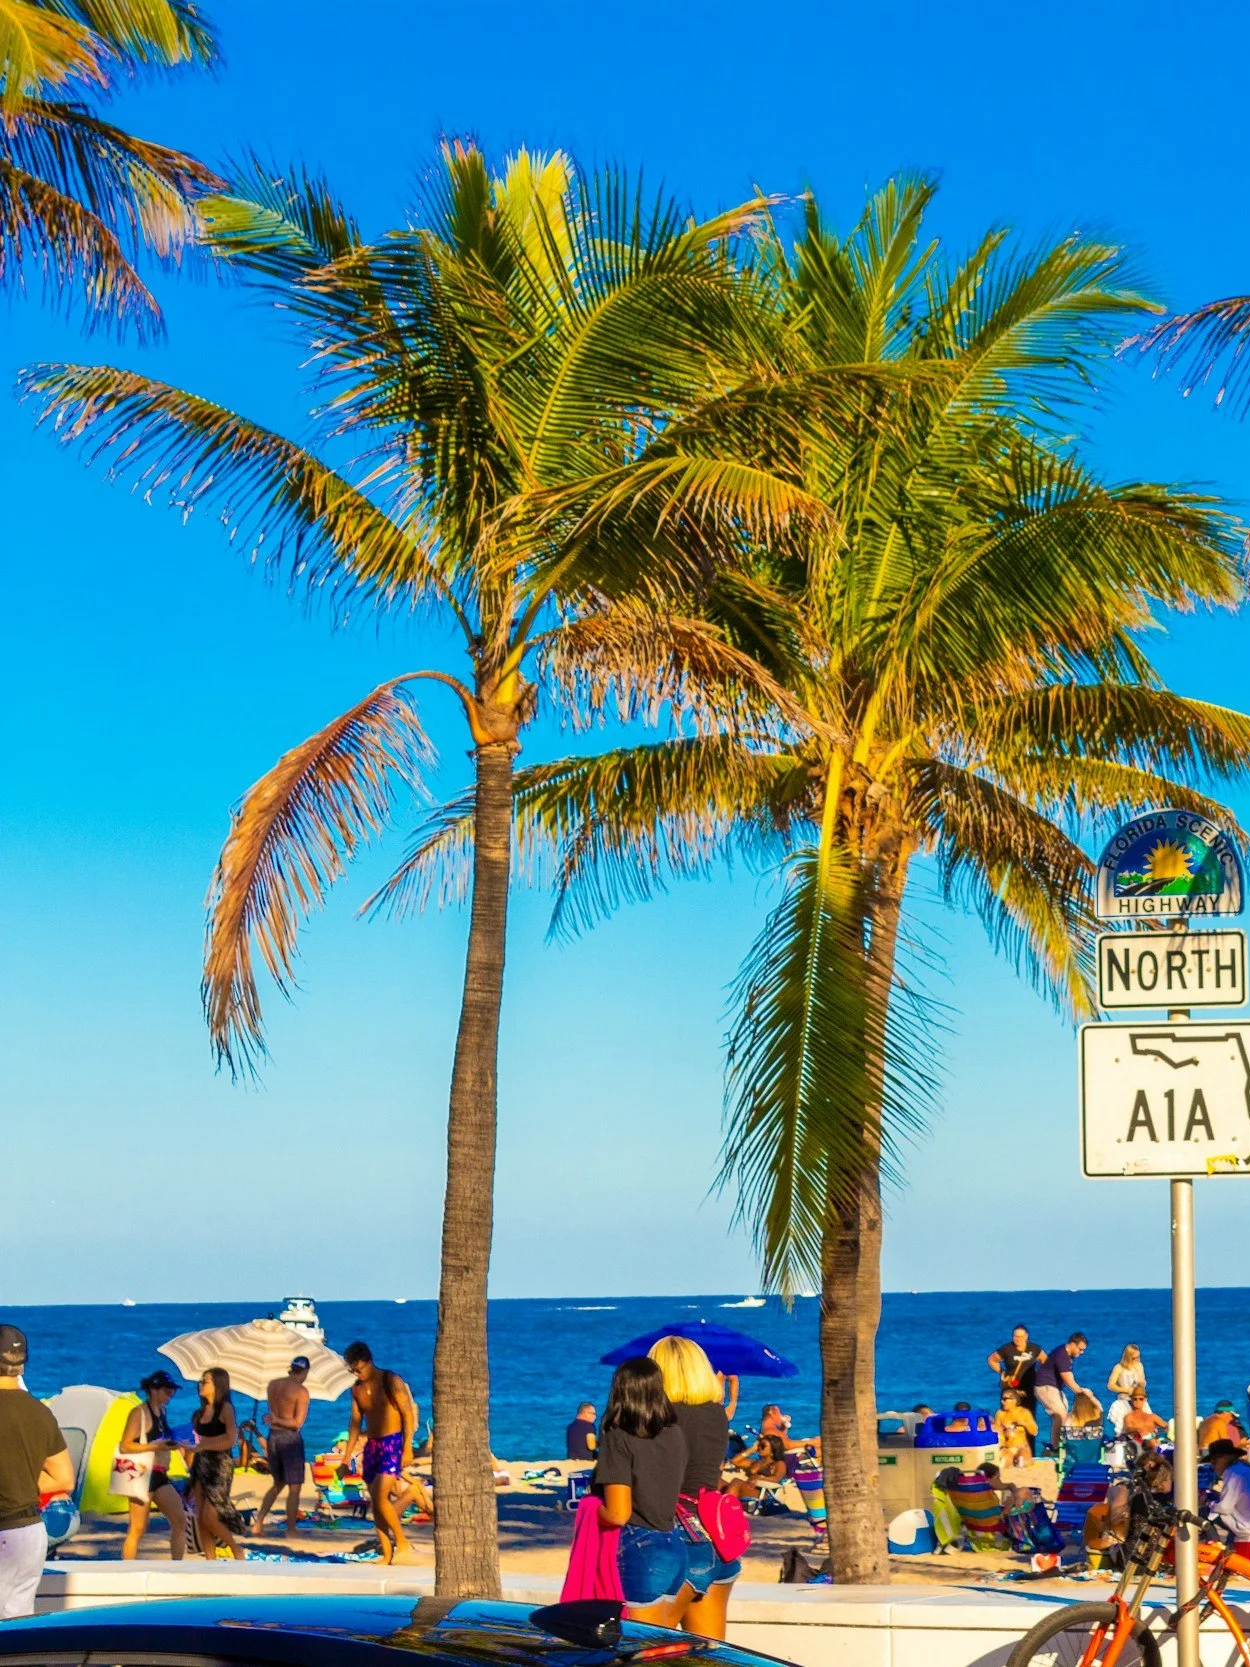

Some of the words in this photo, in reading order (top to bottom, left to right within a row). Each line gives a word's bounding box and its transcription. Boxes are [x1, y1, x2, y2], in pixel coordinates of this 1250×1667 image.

[1103, 814, 1168, 871] FLORIDA
[1176, 814, 1234, 866] SCENIC
[1119, 896, 1220, 914] HIGHWAY
[1107, 947, 1237, 992] NORTH
[1126, 1088, 1215, 1142] A1A
